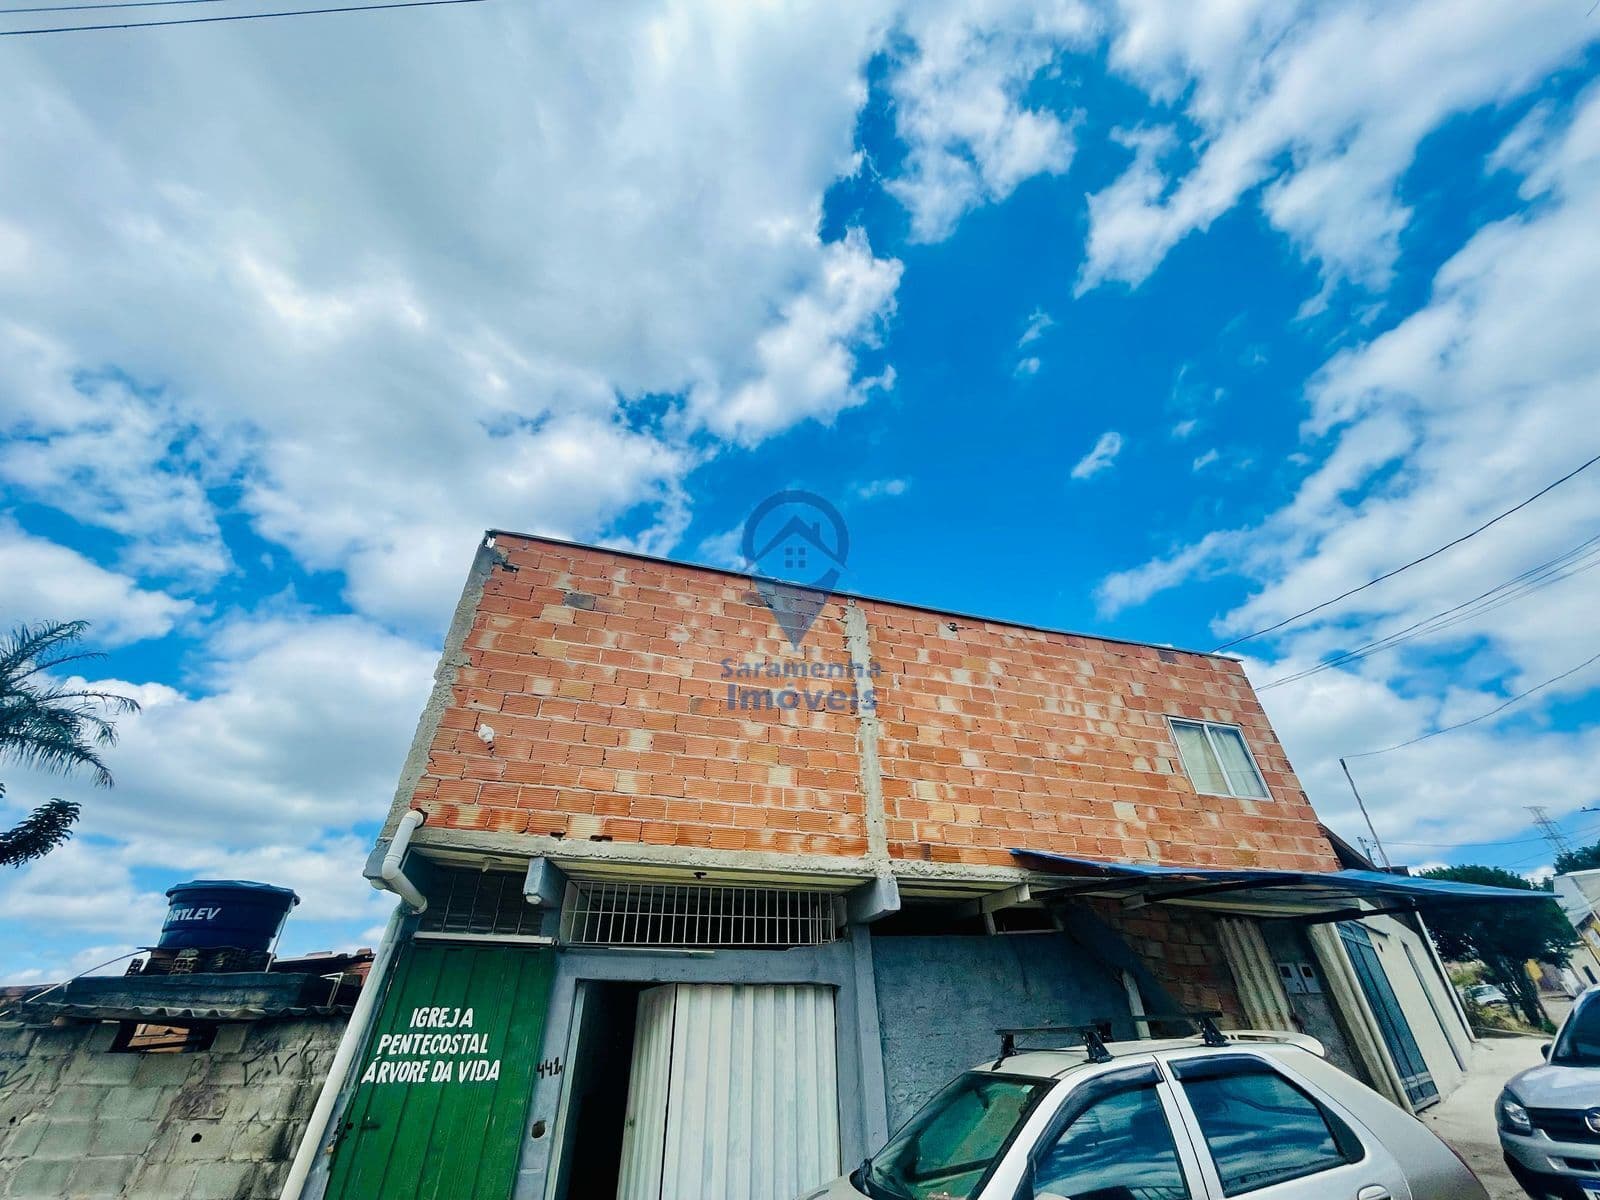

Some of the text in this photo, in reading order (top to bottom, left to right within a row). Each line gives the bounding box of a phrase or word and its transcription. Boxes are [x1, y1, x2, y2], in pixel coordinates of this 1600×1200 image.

[409, 1007, 474, 1028] IGREJA
[376, 1033, 489, 1055] PENTECOSTAL
[360, 1056, 501, 1084] ÁRVORE DA VIDA
